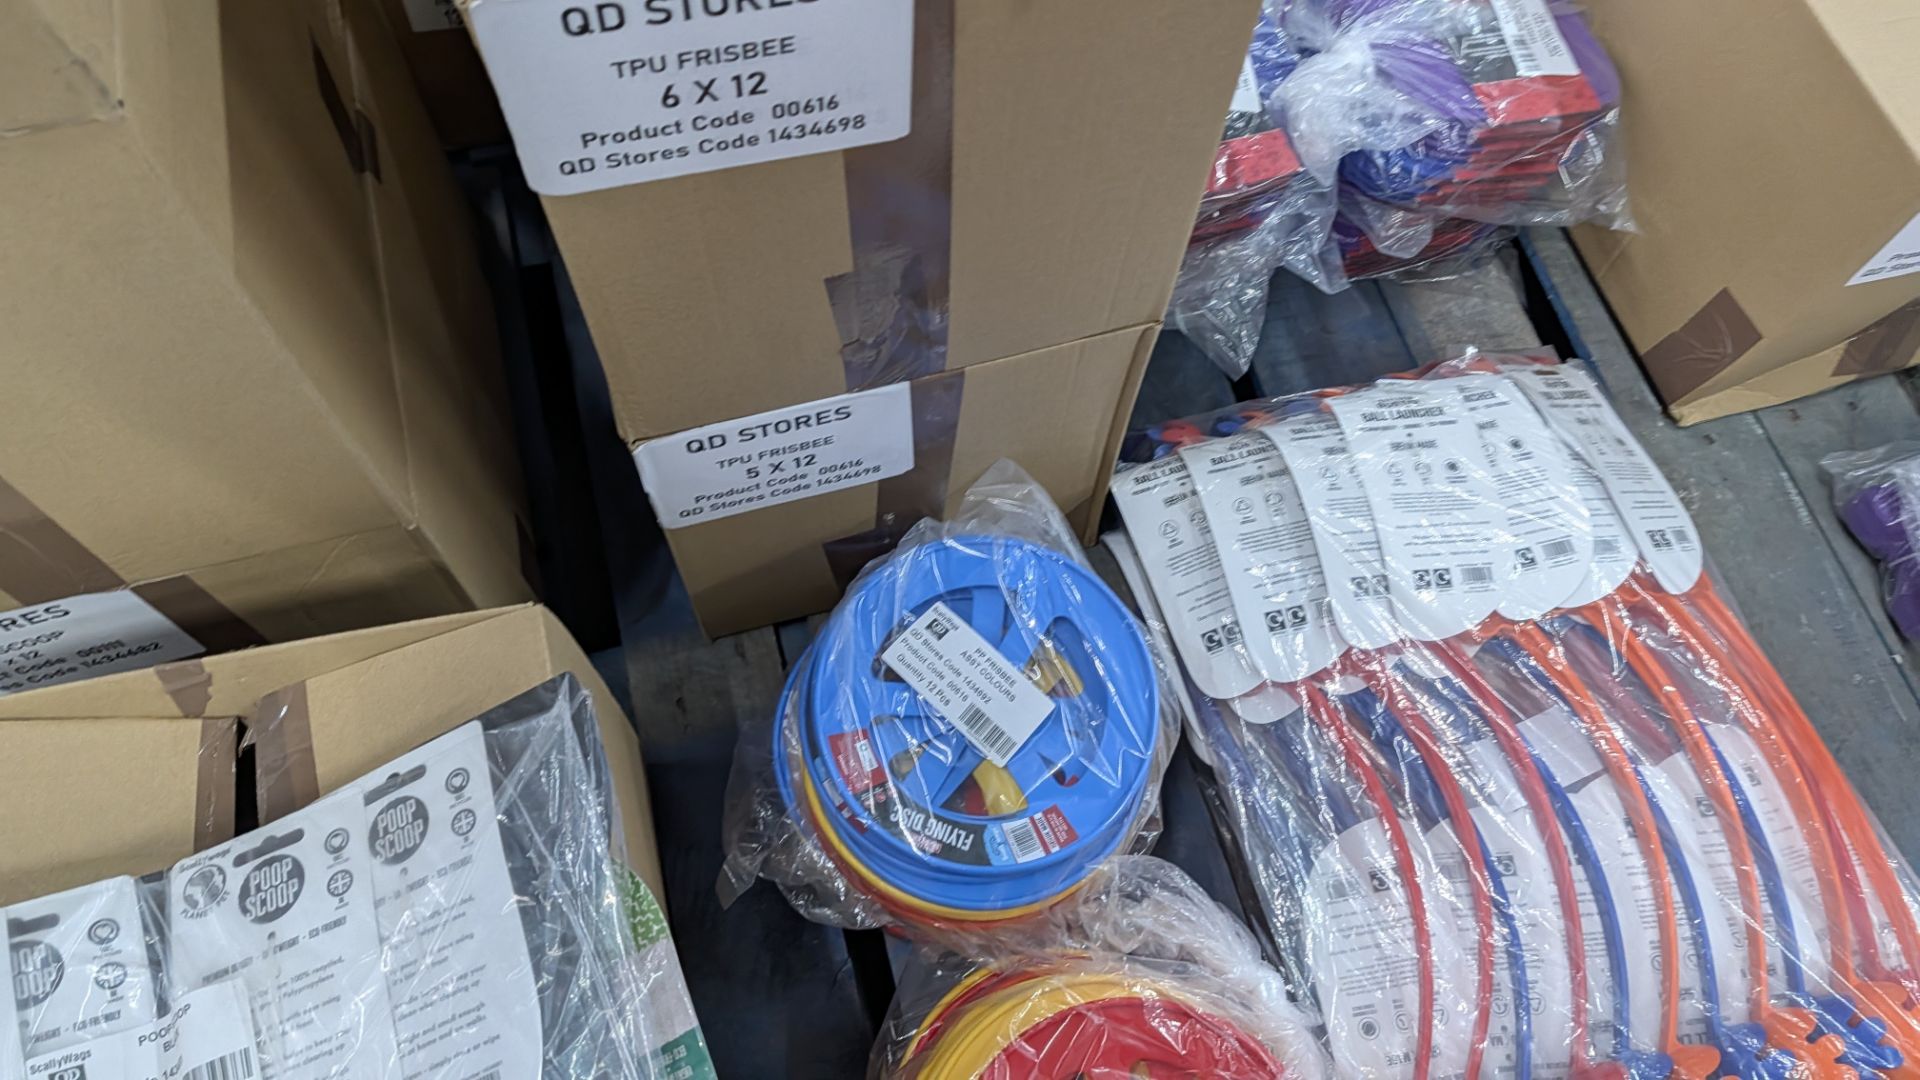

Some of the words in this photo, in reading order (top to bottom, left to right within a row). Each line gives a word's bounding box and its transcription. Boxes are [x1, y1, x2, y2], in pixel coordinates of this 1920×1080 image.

[561, 3, 625, 37] QD
[644, 0, 819, 25] STO
[610, 56, 667, 80] TPU
[678, 35, 796, 71] FRISBEE
[661, 85, 680, 110] 6
[693, 78, 720, 106] X
[733, 71, 769, 98] 12
[581, 118, 683, 149] Product
[691, 107, 755, 132] Code
[772, 94, 840, 121] 00616
[559, 156, 596, 176] QD
[605, 144, 690, 170] Stores
[698, 132, 761, 156] Code
[768, 113, 867, 145] 1434698
[685, 433, 728, 455] QD
[738, 405, 854, 443] STORES
[715, 453, 753, 470] TPU
[758, 434, 836, 461] FRISBEE
[746, 467, 760, 480] 5
[768, 460, 787, 475] X
[793, 453, 819, 469] 12
[679, 506, 705, 519] QD
[709, 493, 766, 514] Stores
[770, 482, 812, 499] Code
[816, 464, 882, 488] 1434698
[694, 482, 762, 505] Product
[766, 471, 809, 488] Code
[818, 457, 865, 476] 00616
[896, 653, 926, 686] Quantity
[926, 679, 936, 692] 12
[900, 637, 928, 665] Product
[925, 661, 945, 682] Code
[920, 637, 944, 662] Stores
[942, 658, 962, 678] Code
[985, 655, 1018, 688] FRISBEE
[979, 666, 1016, 703] COLOURS
[377, 798, 417, 834] POOP
[889, 805, 926, 832] DISC
[924, 818, 975, 852] FLYING
[375, 818, 425, 861] SCOOP
[249, 858, 295, 895] POOP
[245, 878, 300, 922] SCOOP
[29, 1049, 92, 1076] ScallyWags
